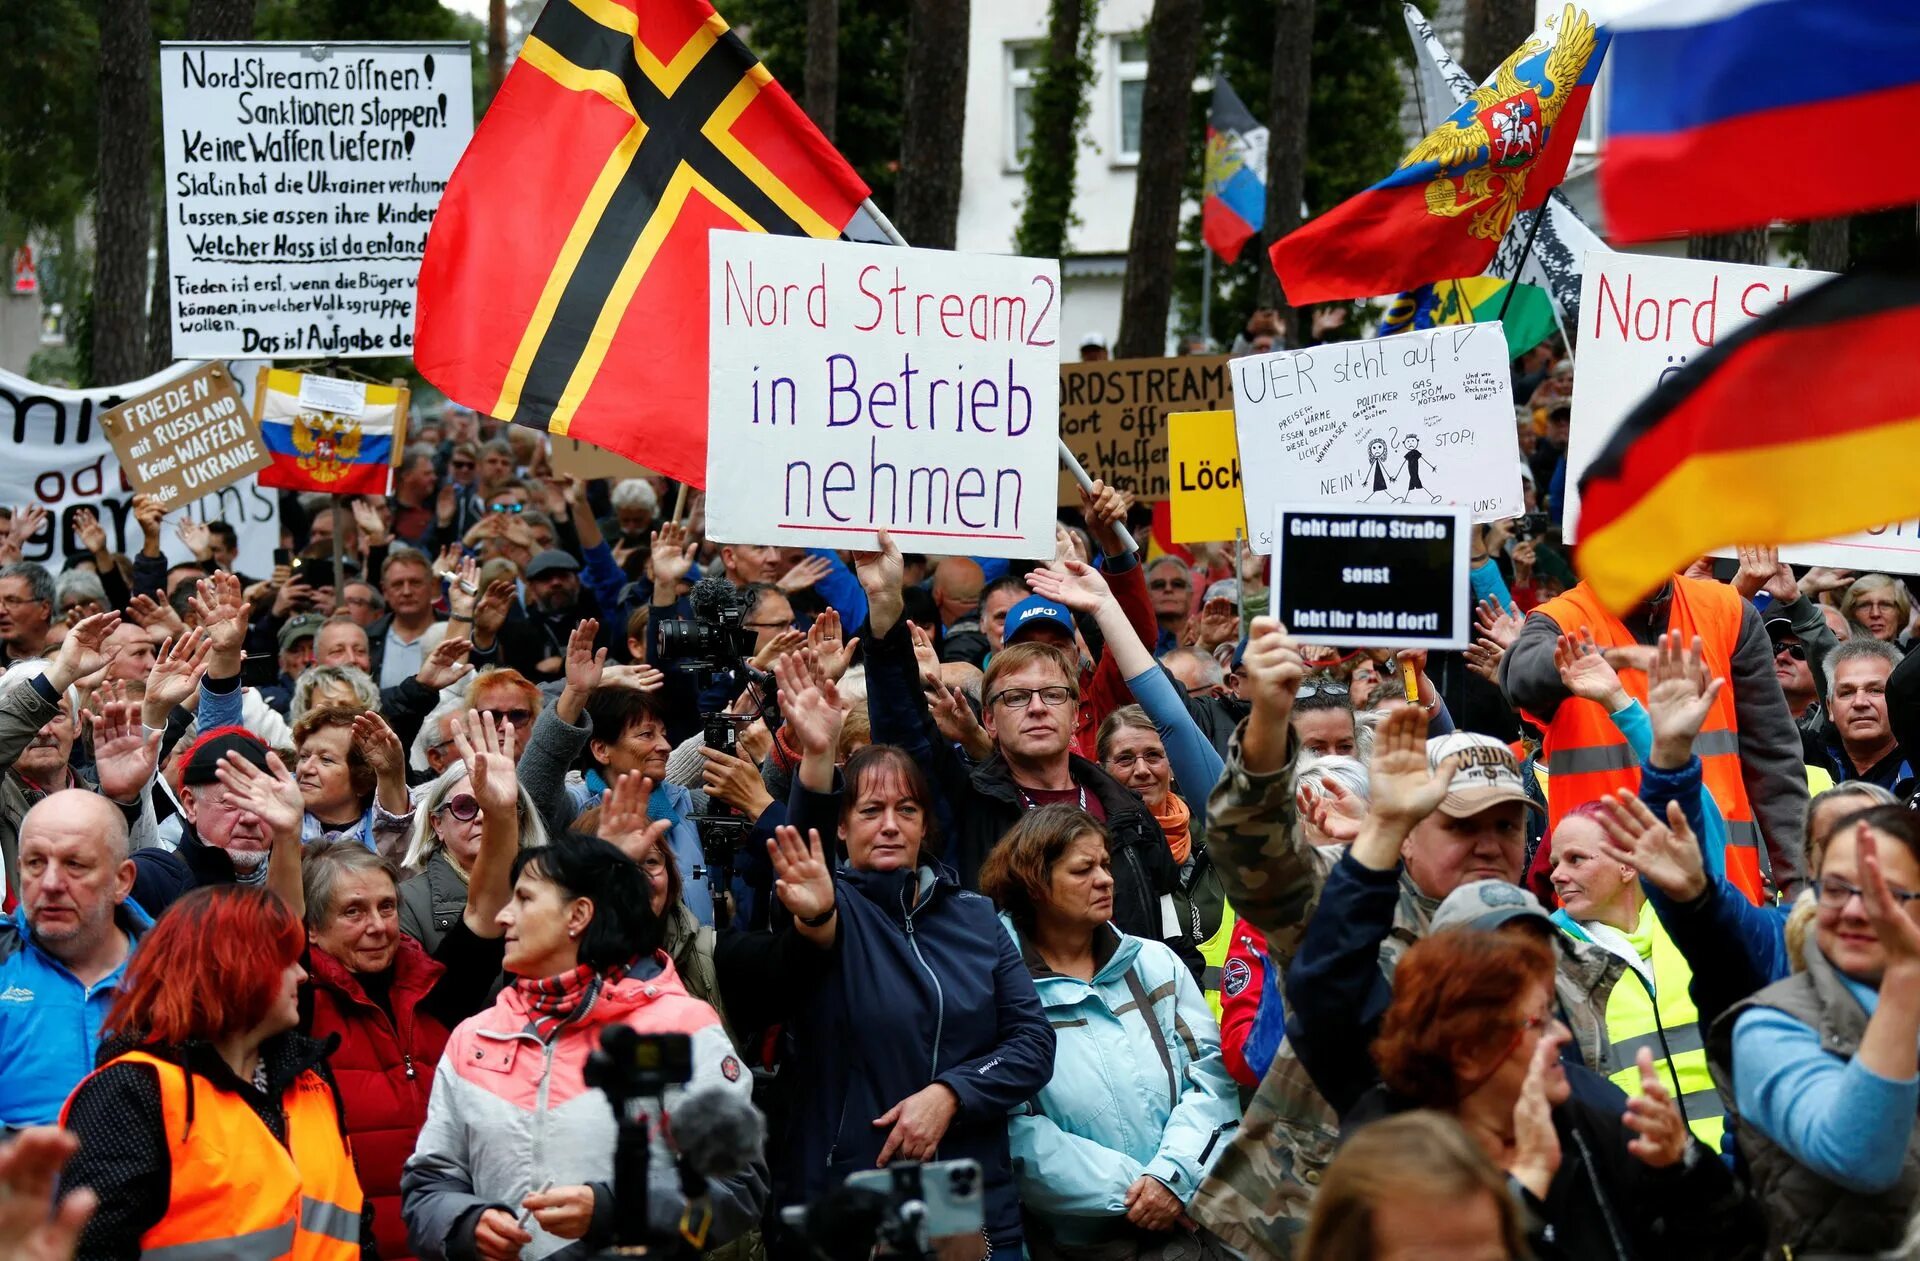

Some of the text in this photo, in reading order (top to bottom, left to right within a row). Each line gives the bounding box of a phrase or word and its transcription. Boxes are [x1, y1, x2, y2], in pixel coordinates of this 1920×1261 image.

[345, 54, 435, 91] öffnen!
[237, 92, 447, 132] Sanktionen stoppen!
[182, 129, 247, 163] Keine
[248, 129, 325, 163] Waffen
[275, 172, 303, 194] die
[307, 170, 385, 194] Ukrainer
[273, 210, 328, 224] assen
[335, 202, 370, 224] ihre
[186, 233, 270, 257] Welcher
[274, 234, 315, 258] Hass
[320, 236, 337, 256] ist
[342, 233, 362, 255] da
[231, 273, 249, 292] ist
[290, 280, 329, 290] wenn
[335, 272, 356, 289] die
[242, 299, 256, 314] in
[259, 298, 310, 312] welcher
[313, 293, 411, 319] Volksgruppe
[726, 260, 1055, 347] Nord Stream2
[1595, 272, 1718, 347] Nord
[241, 324, 414, 353] Das ist Aufgabe de
[1242, 352, 1318, 403] UER
[1334, 340, 1388, 384] steht
[752, 353, 1032, 436] in Betrieb
[1410, 385, 1443, 401] STROM
[1412, 379, 1432, 389] GAS
[1356, 391, 1399, 409] POLITIKER
[1418, 393, 1455, 406] NOTSTAND
[130, 396, 236, 459] mit RUSSLAND
[1278, 408, 1306, 430] PREISE
[1280, 429, 1304, 442] ESSEN
[1308, 421, 1337, 437] BENZIN
[1435, 429, 1475, 446] STOP!
[137, 415, 246, 483] Keine WAFFEN
[1285, 438, 1309, 452] DIESEL
[1298, 444, 1320, 461] LICHT
[182, 440, 259, 489] UKRAINE
[785, 435, 1022, 530] nehmen
[1290, 518, 1446, 539] Geht auf die Straße
[1342, 567, 1390, 583] sonst
[1293, 609, 1438, 631] lebt ihr bald dort!
